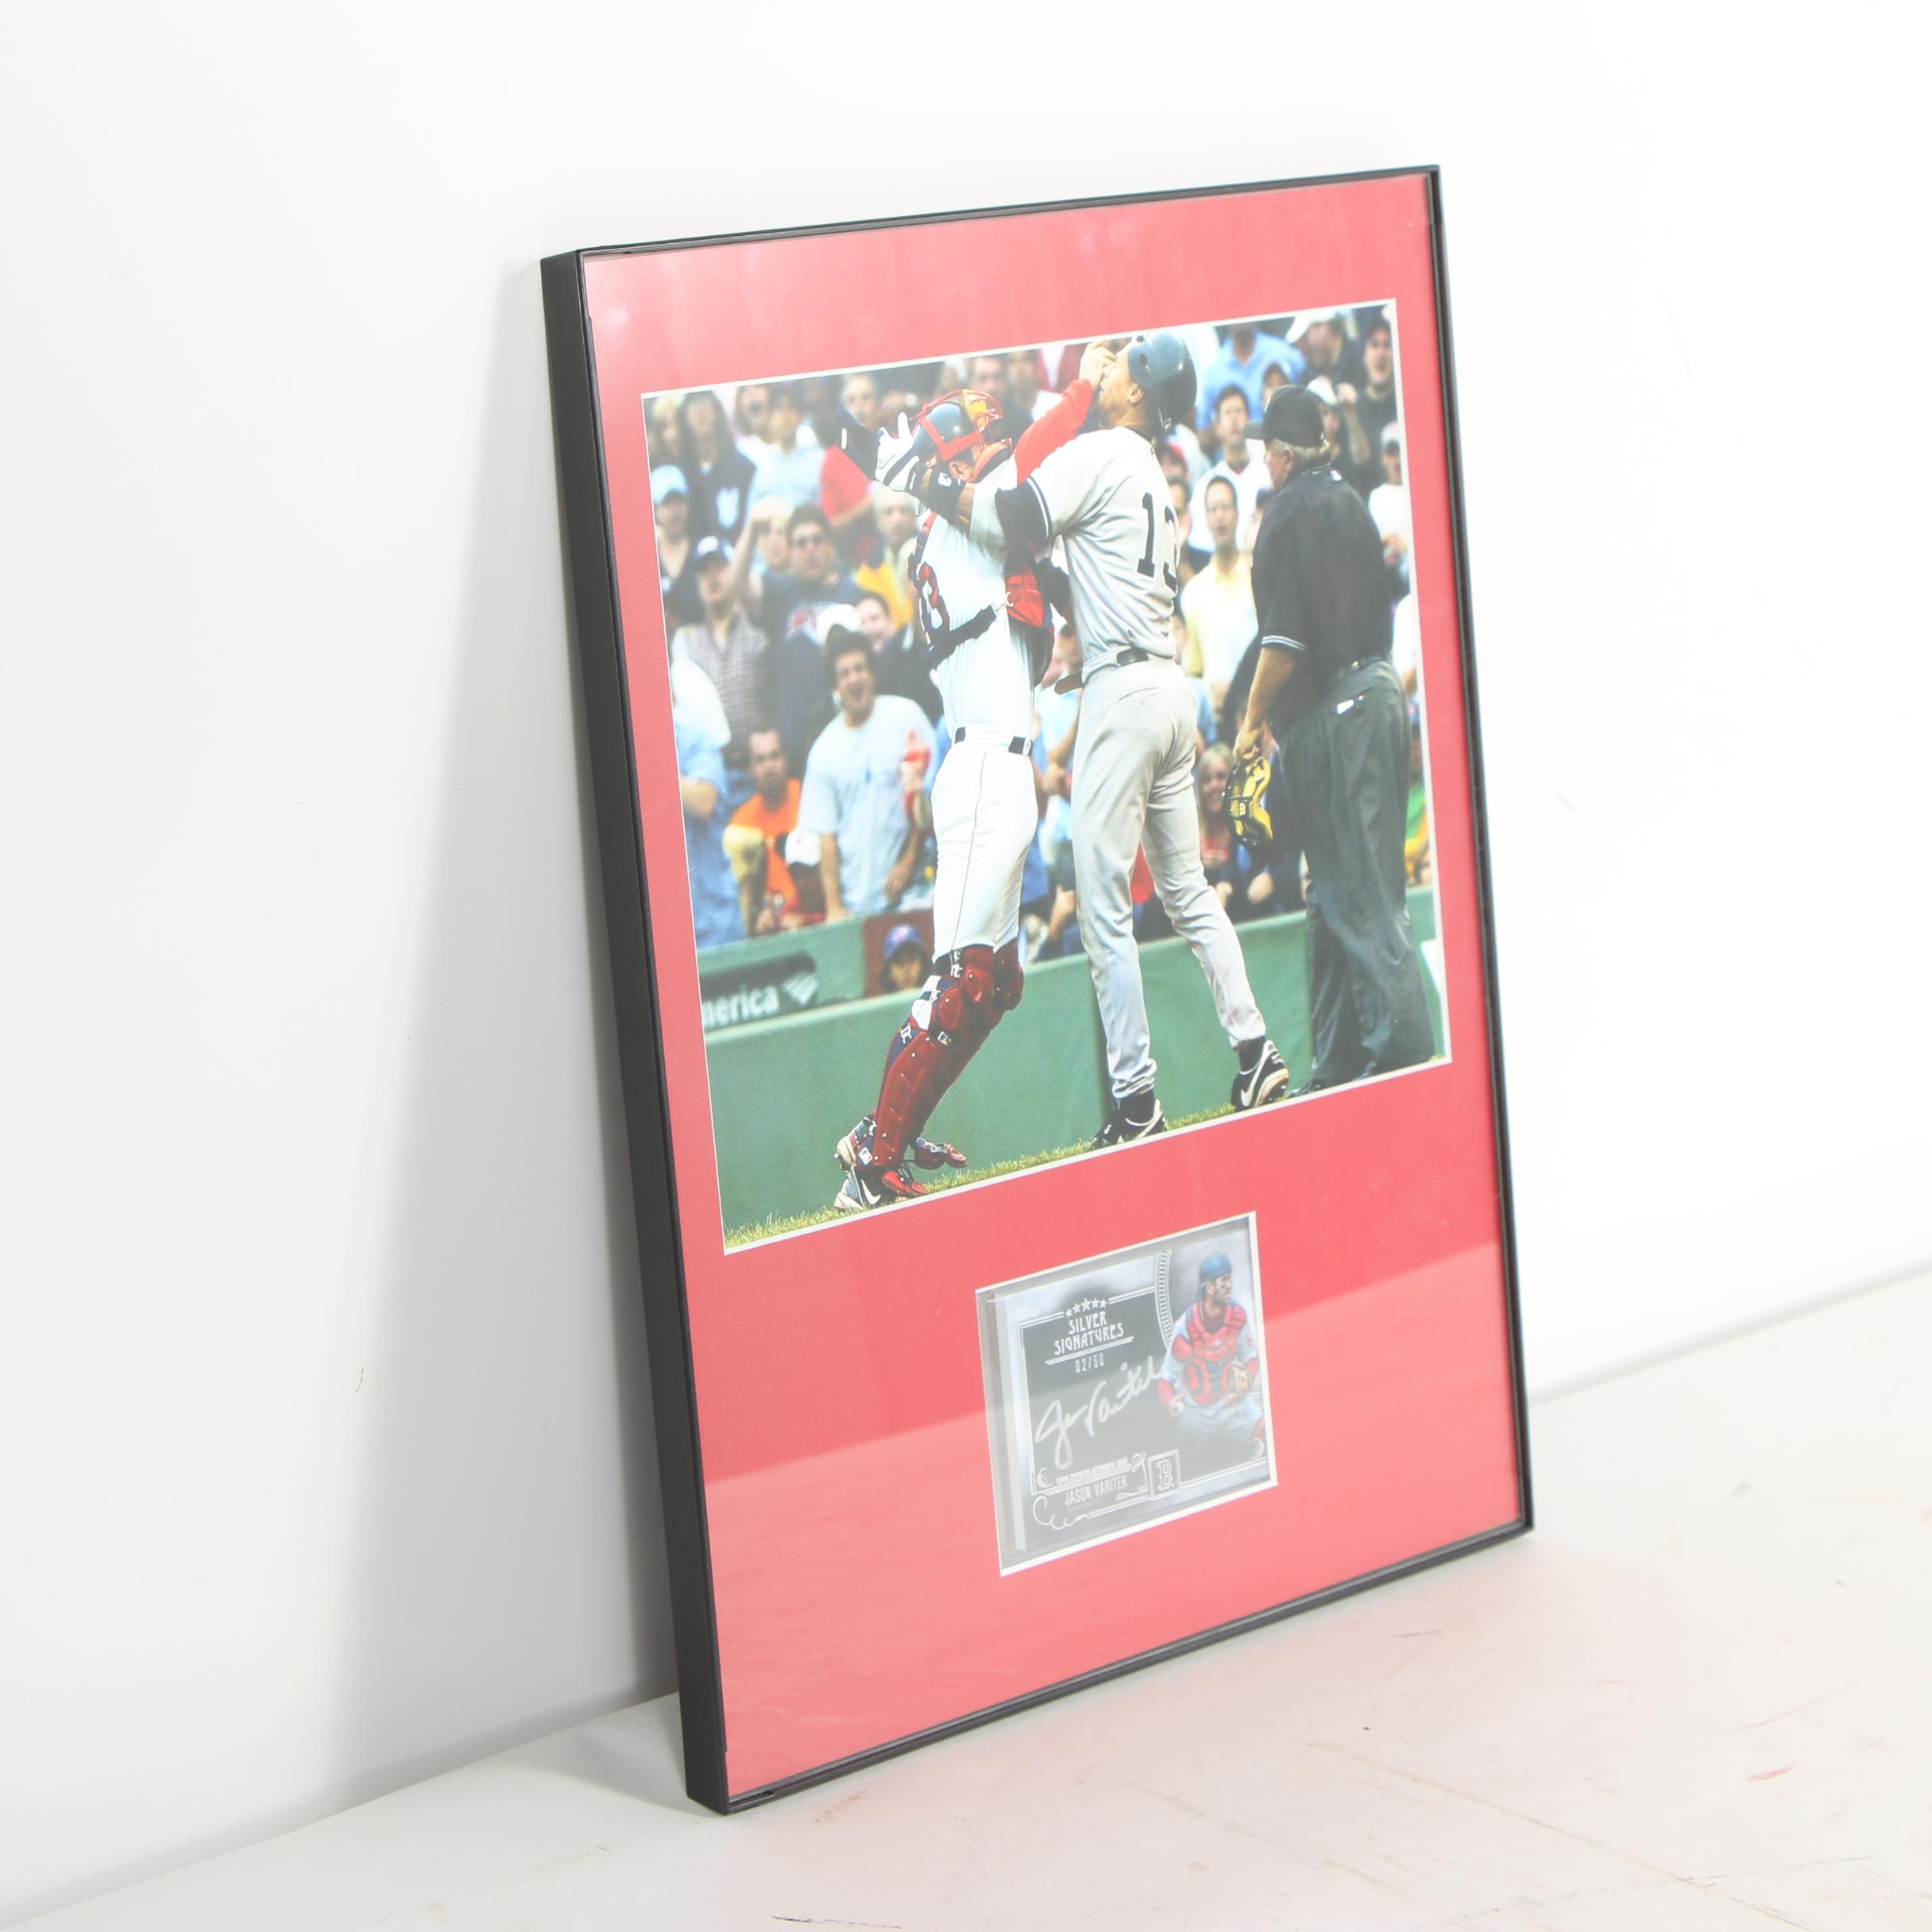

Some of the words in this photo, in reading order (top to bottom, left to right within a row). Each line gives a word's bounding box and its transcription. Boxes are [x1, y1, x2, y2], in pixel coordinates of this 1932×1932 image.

[1068, 1310, 1107, 1334] SILVER
[1053, 1322, 1124, 1354] SIGNATURES
[1075, 1353, 1104, 1374] 02/50
[1065, 1486, 1092, 1506] JASON
[1094, 1474, 1128, 1497] VARITEK
